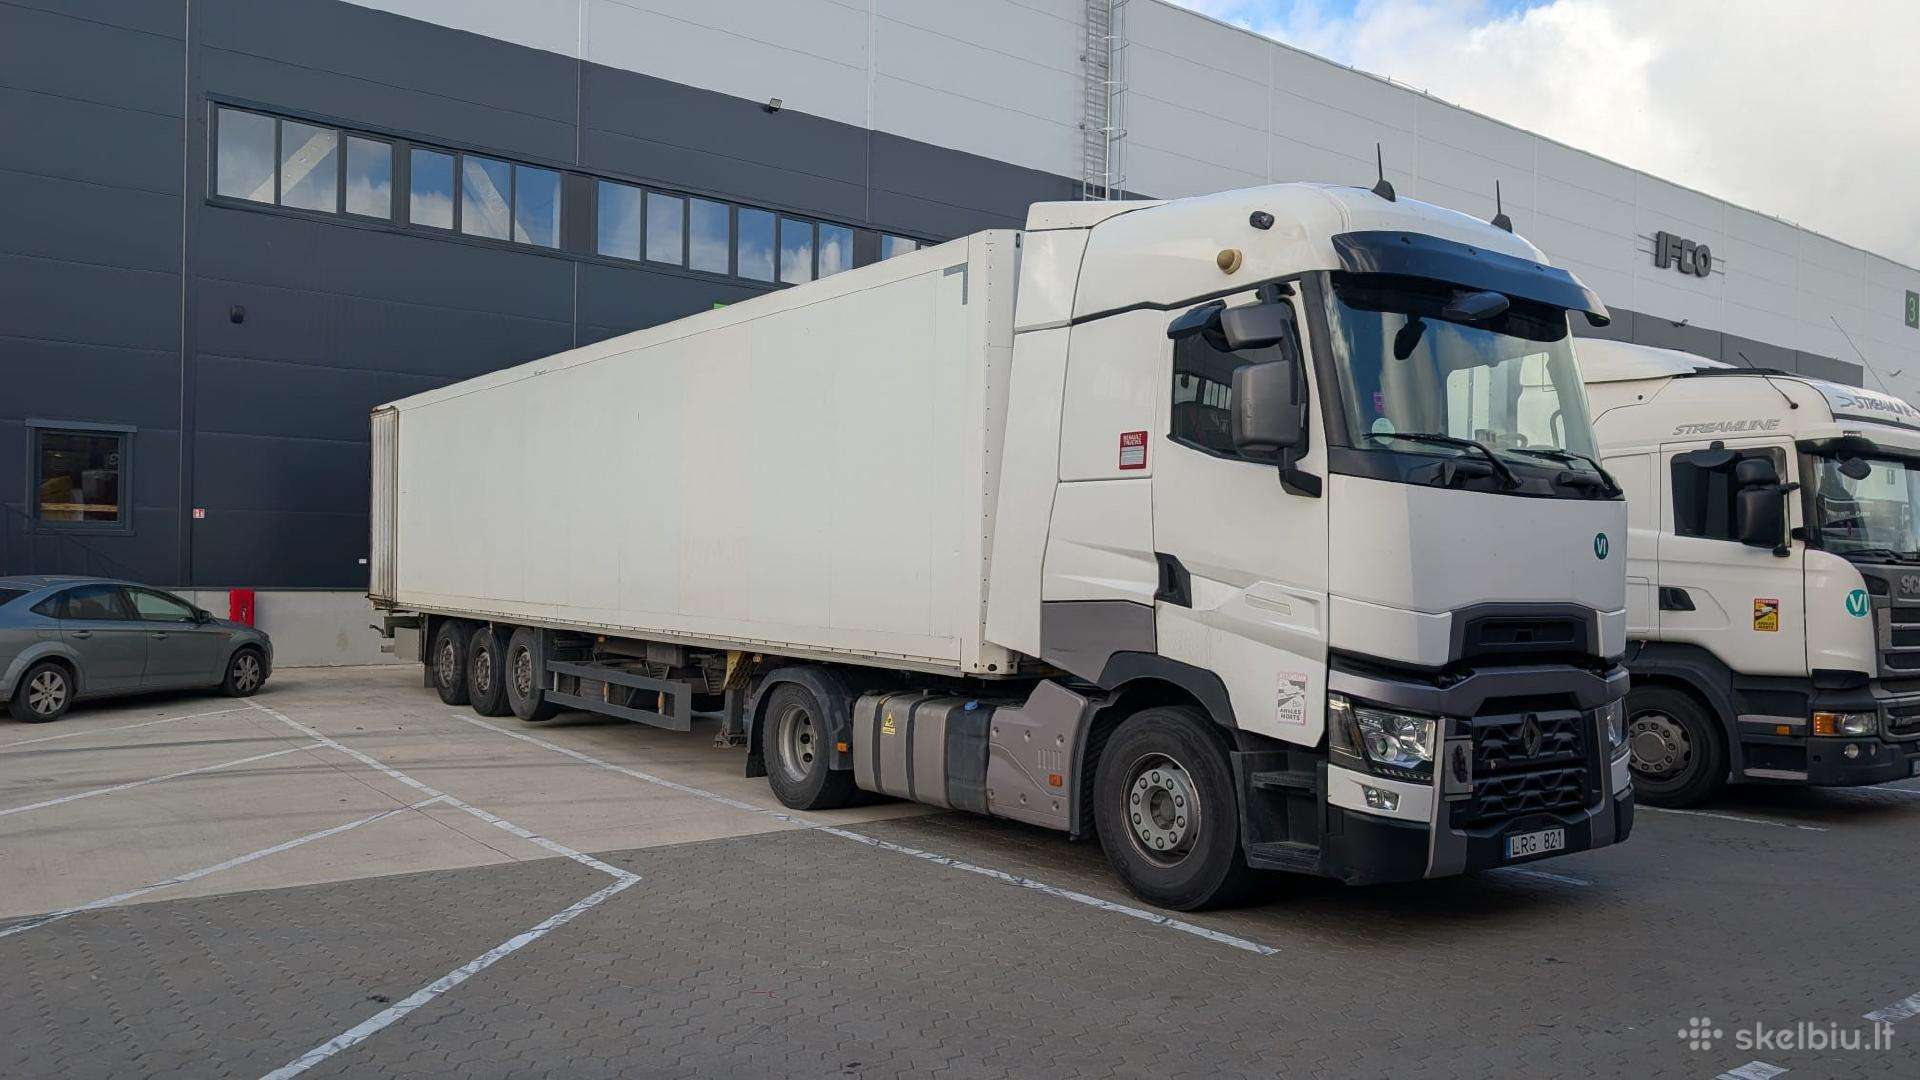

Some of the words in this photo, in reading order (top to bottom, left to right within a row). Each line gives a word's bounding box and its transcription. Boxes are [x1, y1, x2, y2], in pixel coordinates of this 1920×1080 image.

[1655, 230, 1712, 278] IFCO
[1909, 296, 1916, 322] 3
[1671, 418, 1781, 436] STREAMLINE
[1512, 835, 1536, 855] LRG
[1544, 831, 1562, 849] 821
